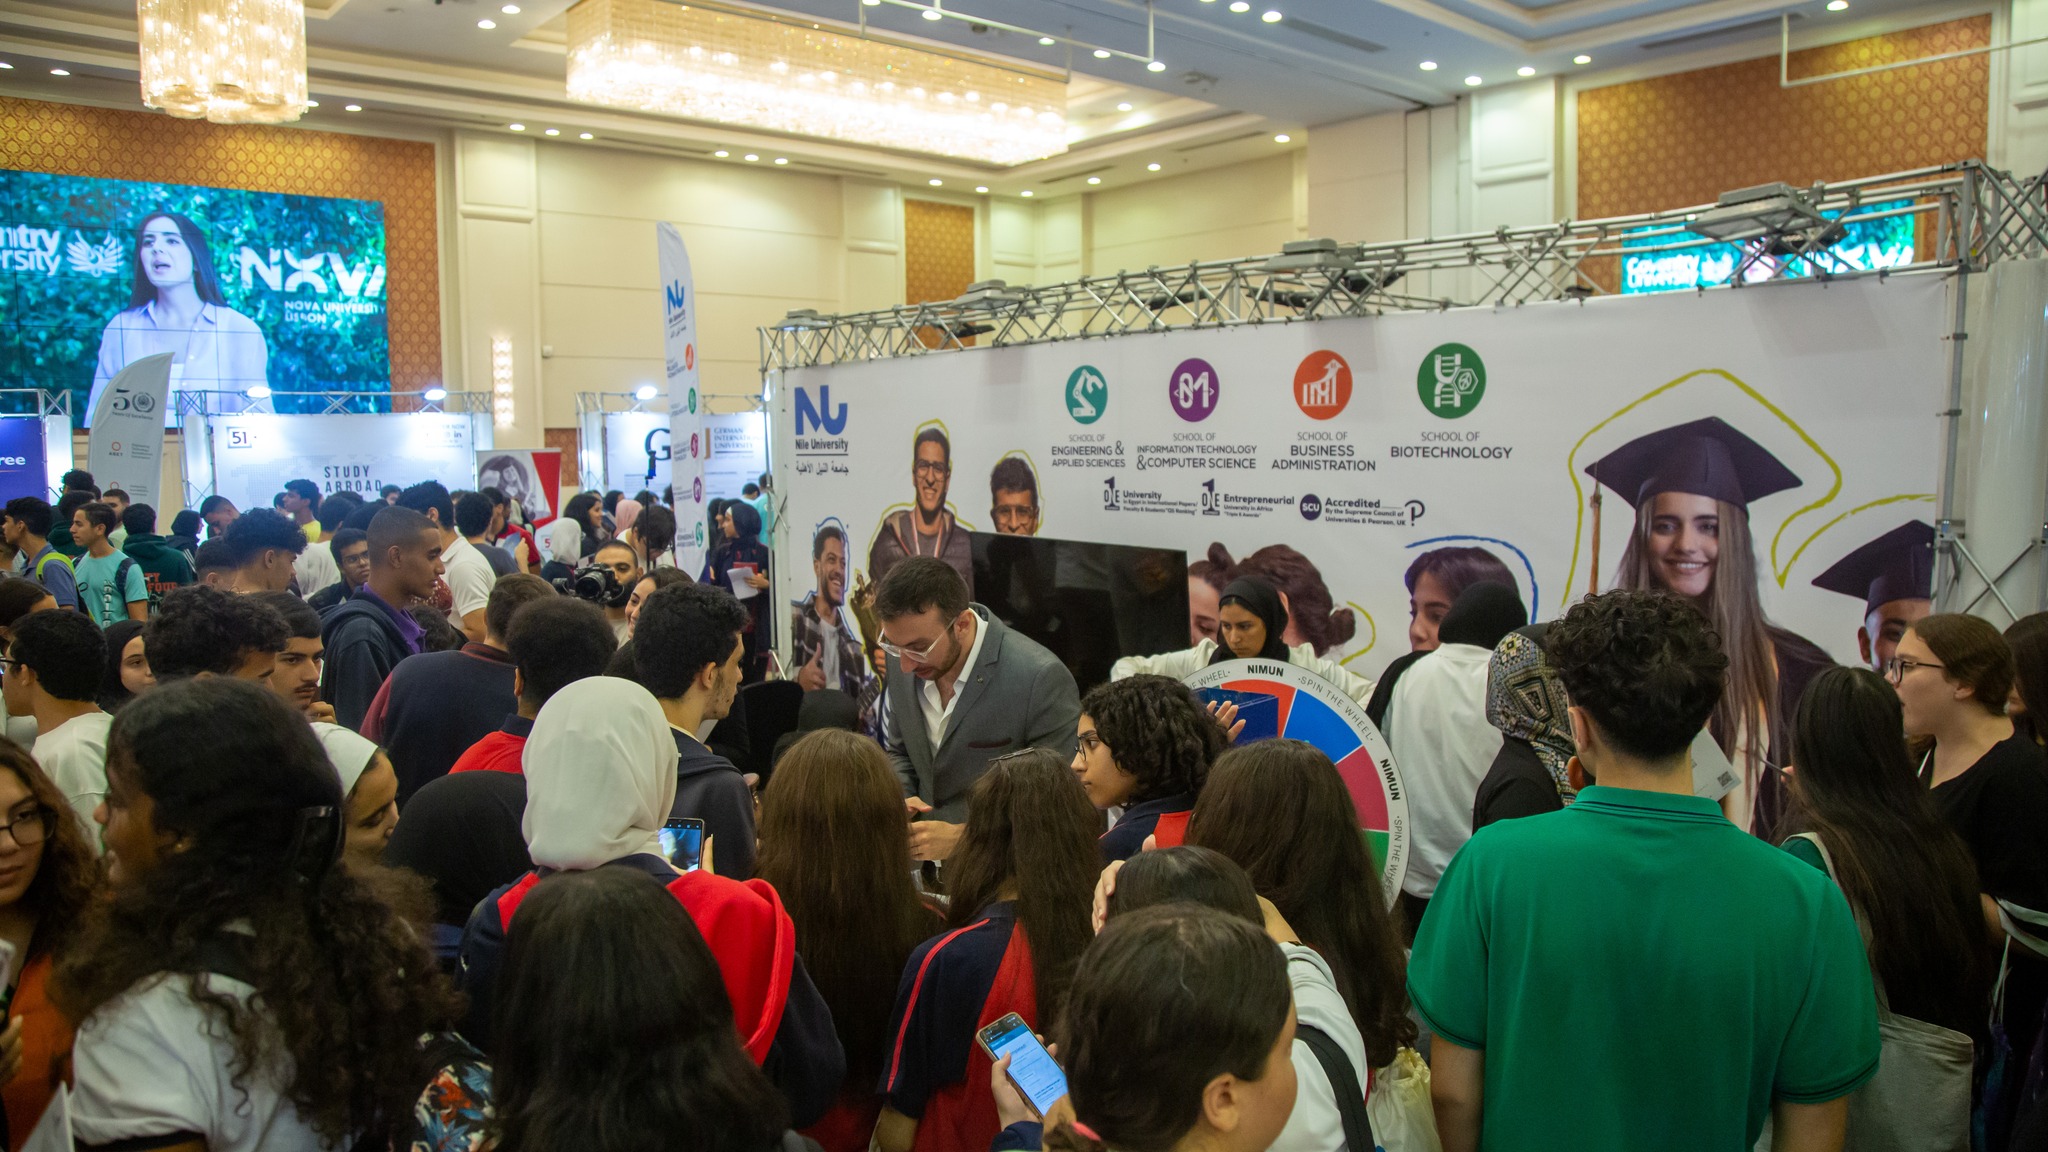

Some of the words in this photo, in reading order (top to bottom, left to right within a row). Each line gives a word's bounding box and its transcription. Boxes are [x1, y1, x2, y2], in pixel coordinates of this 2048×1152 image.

[284, 301, 321, 311] NOVA
[794, 384, 848, 436] NU
[231, 431, 247, 445] 51
[1068, 434, 1096, 442] SCHOOL
[1097, 434, 1106, 442] OF
[1173, 433, 1203, 442] SCHOOL
[1206, 432, 1216, 441] OF
[1297, 431, 1333, 441] SCHOOL
[1336, 431, 1348, 441] OF
[1421, 431, 1463, 442] SCHOOL
[1466, 431, 1481, 442] OF
[795, 439, 809, 450] Nile
[811, 438, 848, 452] University
[1051, 446, 1112, 456] ENGINEERING
[1115, 440, 1124, 455] &
[1137, 445, 1195, 454] INFORMATION
[1196, 445, 1257, 454] TECHNOLOGY
[1290, 445, 1355, 457] BUSINESS
[1390, 446, 1513, 459] BIOTECHNOLOGY
[1052, 459, 1085, 467] APPLIED
[1086, 459, 1126, 468] SCIENCES
[1208, 458, 1256, 469] SCIENCE
[1271, 459, 1376, 471] ADMINISTRATION
[324, 465, 369, 478] STUDY
[325, 480, 382, 493] ABROAD
[1123, 490, 1162, 501] University
[1224, 494, 1295, 505] Entrepreneurial
[1302, 503, 1320, 512] SCU
[1325, 497, 1380, 508] Accredited
[1373, 509, 1396, 517] Council
[1325, 516, 1361, 524] Universities
[1247, 664, 1284, 678] NIMUN
[1326, 690, 1345, 707] THE
[1380, 758, 1401, 801] NIMUN
[1391, 844, 1402, 862] THE
